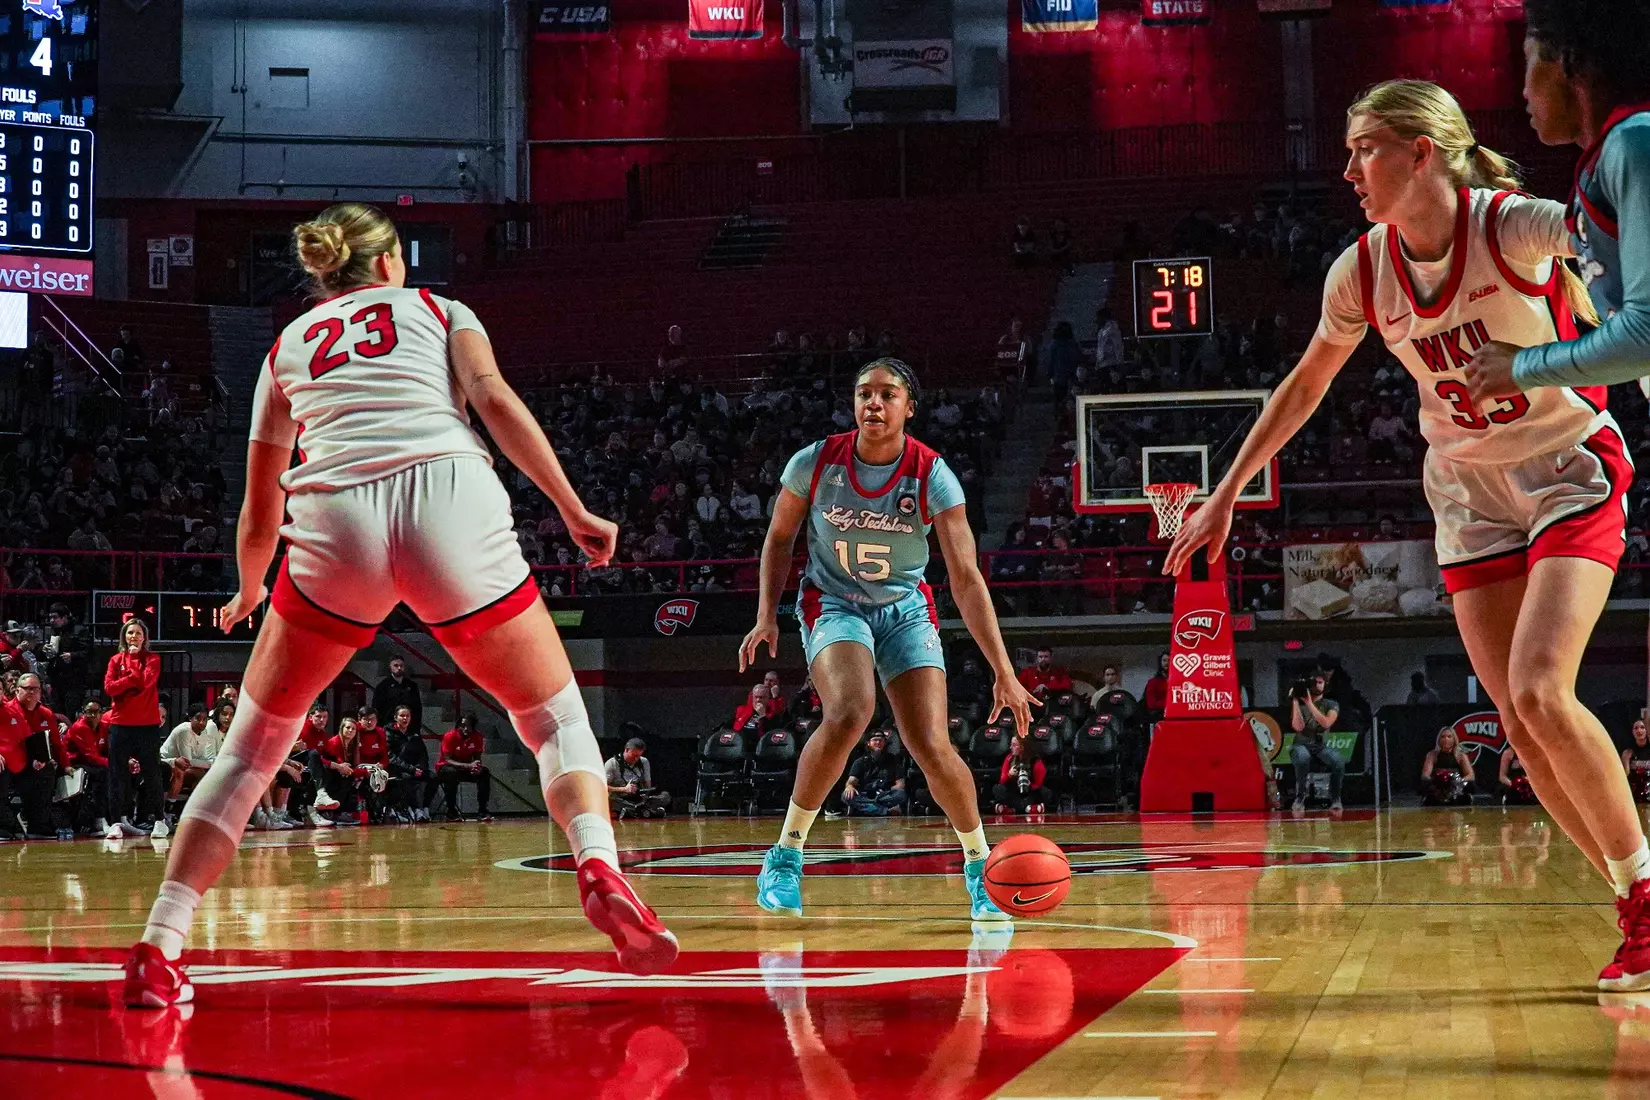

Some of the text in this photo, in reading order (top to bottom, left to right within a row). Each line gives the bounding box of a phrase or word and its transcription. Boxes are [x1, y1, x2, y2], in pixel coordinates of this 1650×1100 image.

[708, 7, 744, 20] WKU
[1152, 1, 1203, 15] STATE
[30, 37, 52, 76] 4
[2, 87, 37, 104] FOULS
[22, 111, 52, 124] POINTS
[60, 114, 86, 127] FOULS
[34, 135, 44, 152] 0
[70, 138, 80, 155] 0
[33, 157, 43, 174] 0
[69, 160, 80, 177] 0
[32, 179, 42, 196] 0
[69, 182, 79, 199] 0
[31, 200, 42, 217] 0
[68, 203, 79, 220] 0
[31, 223, 42, 239] 0
[68, 225, 79, 242] 0
[1157, 265, 1203, 287] 7:18
[1151, 290, 1197, 329] 21
[303, 302, 399, 381] 23
[822, 504, 914, 534] Lady Techsters
[834, 539, 892, 582] 15
[100, 594, 135, 609] WKU
[666, 605, 688, 616] WKU
[1187, 616, 1213, 629] WKU
[1202, 653, 1231, 661] Graves
[1202, 661, 1231, 669] Gilbert
[1203, 669, 1224, 677] Clinic
[1188, 702, 1221, 711] MOVING
[1464, 721, 1499, 737] WKU
